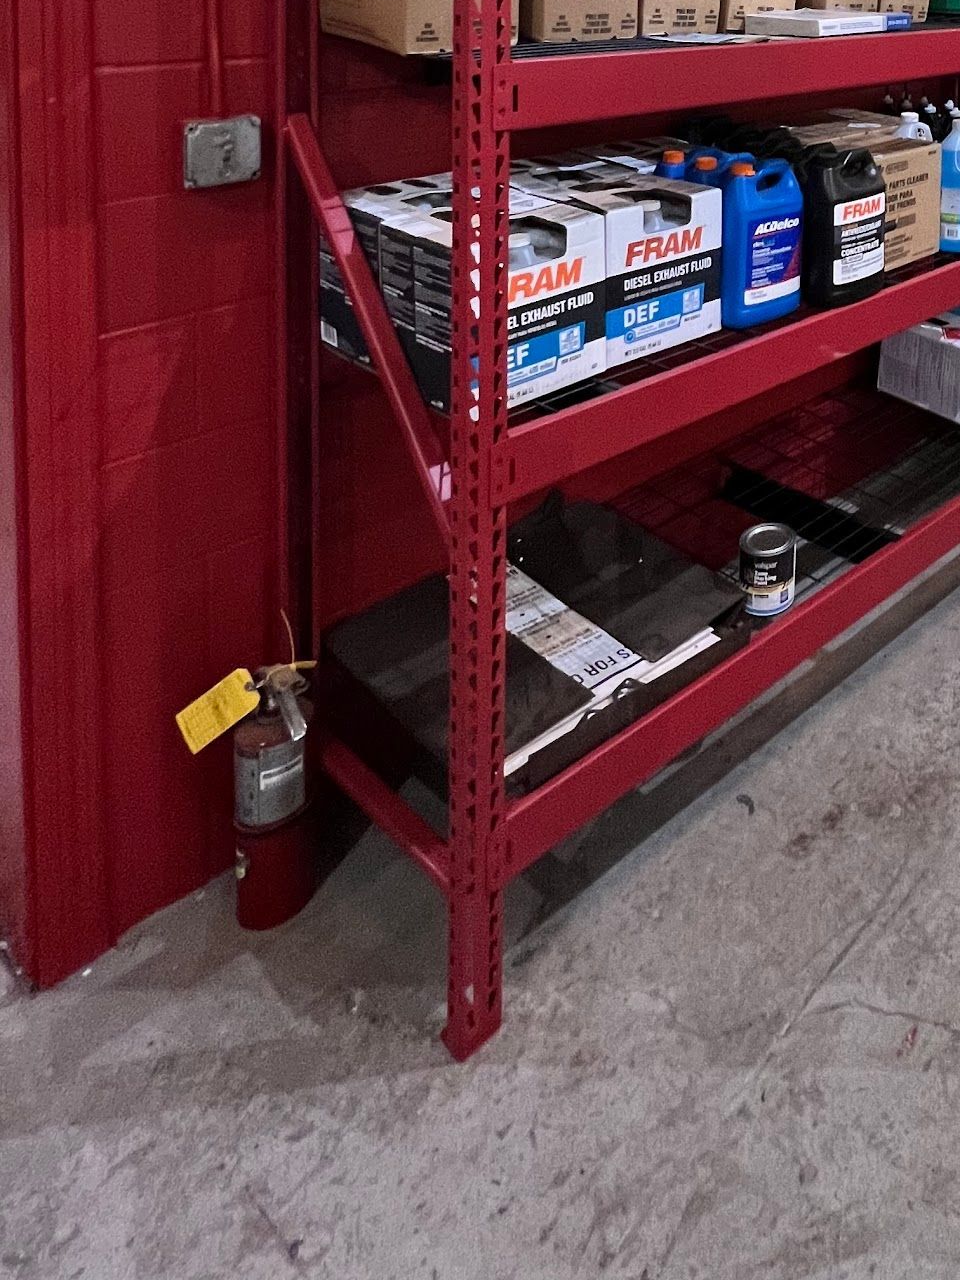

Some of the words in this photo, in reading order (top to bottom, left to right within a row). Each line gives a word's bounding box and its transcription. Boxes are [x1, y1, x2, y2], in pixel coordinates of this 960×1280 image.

[842, 197, 881, 221] FRAM
[754, 217, 800, 236] ACDelco
[625, 226, 704, 267] FRAM
[508, 257, 584, 304] RAM
[623, 273, 653, 292] DIESEL
[653, 262, 691, 284] EXHAUST
[690, 256, 712, 273] FLUID
[520, 297, 567, 326] EXHAUST
[567, 291, 595, 311] FLUID
[623, 300, 660, 328] DEF
[507, 343, 530, 370] EF
[583, 655, 618, 677] FOR
